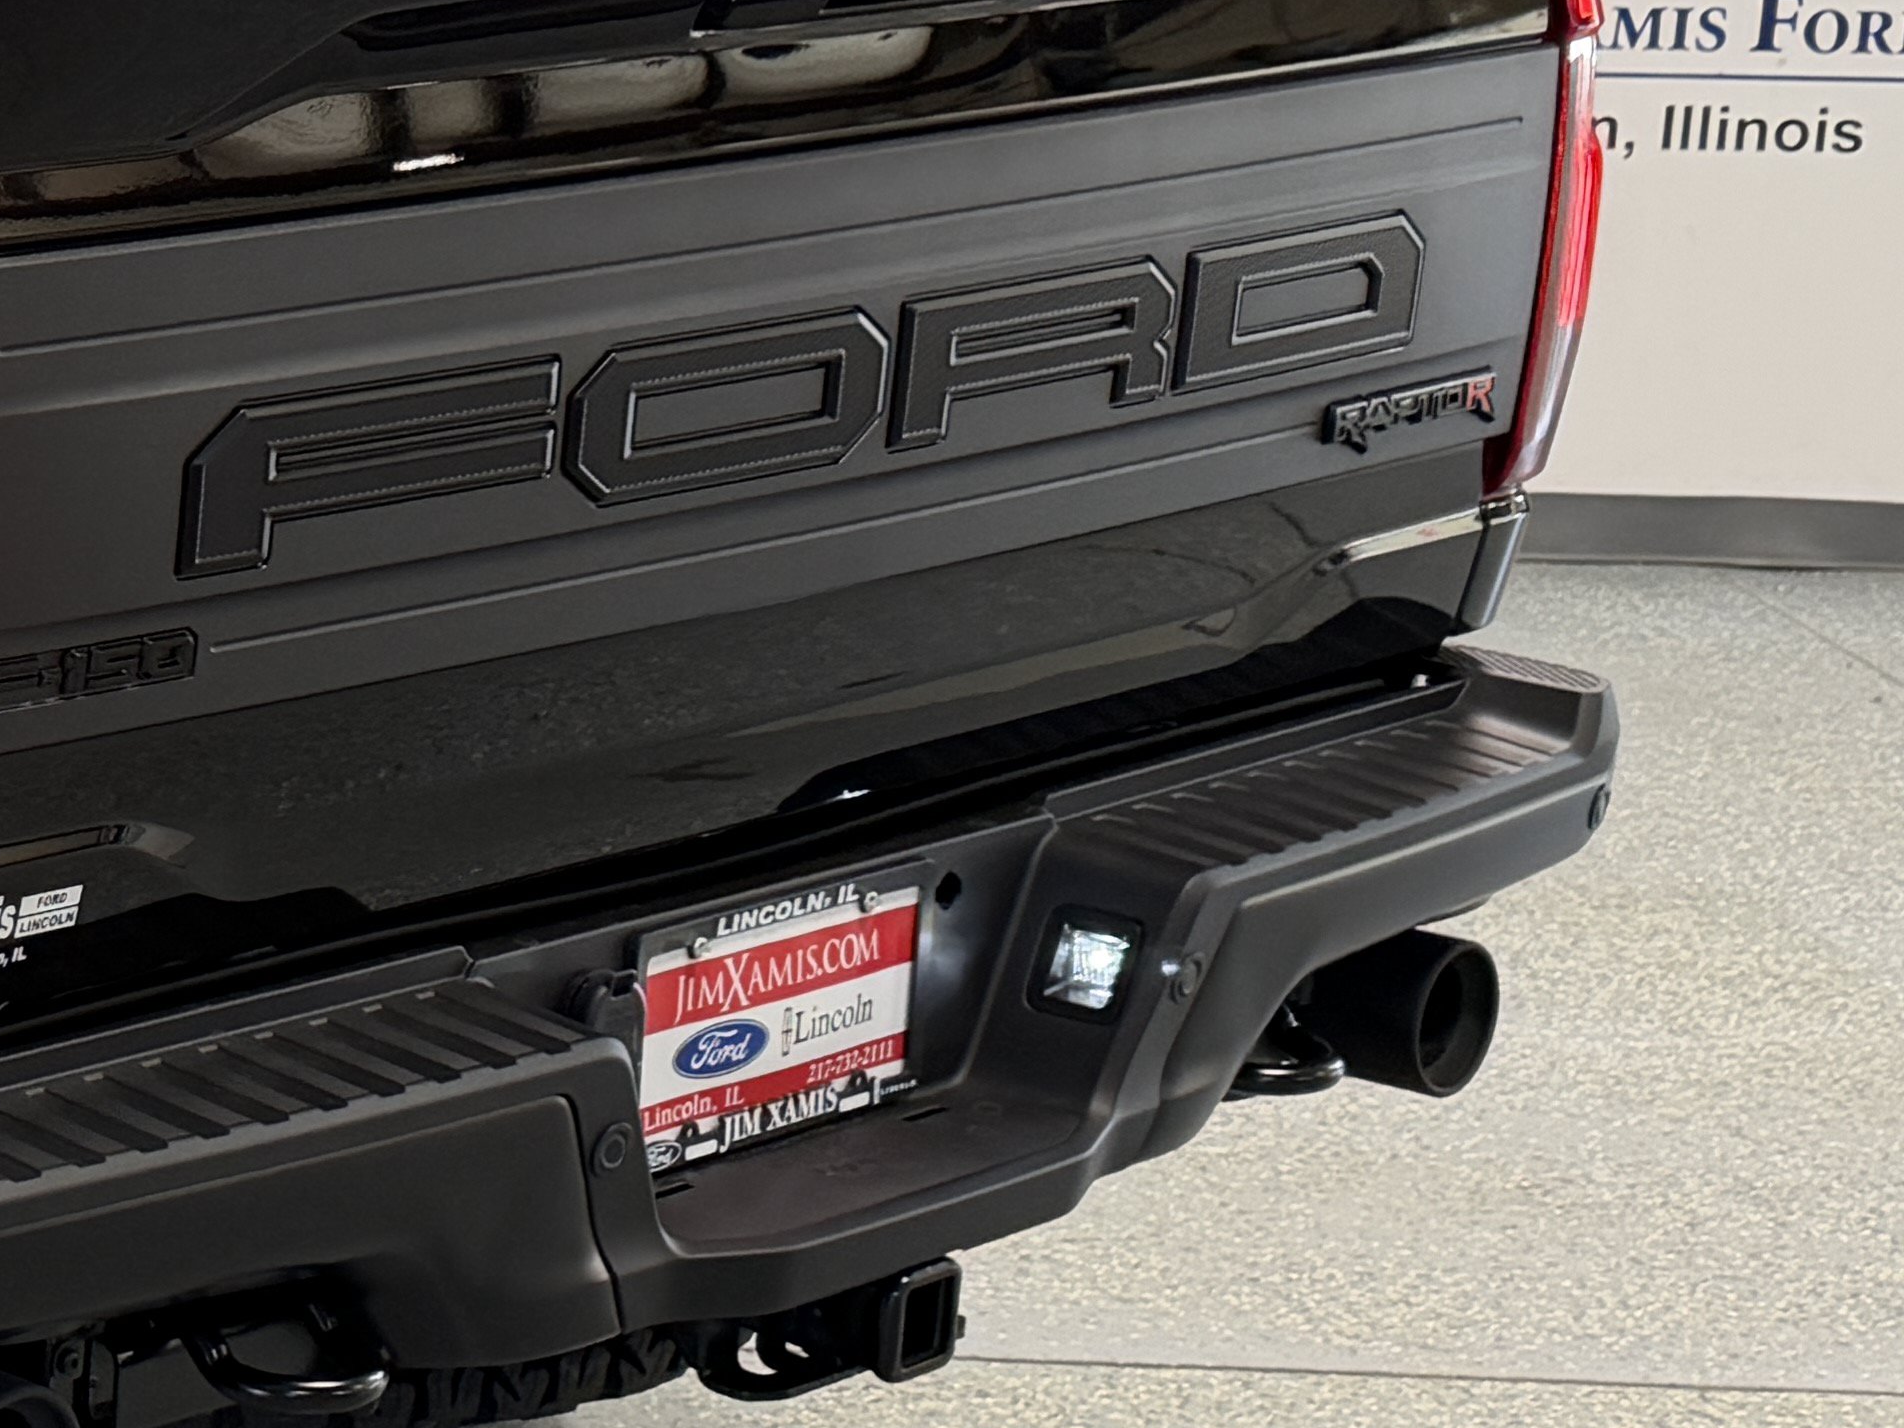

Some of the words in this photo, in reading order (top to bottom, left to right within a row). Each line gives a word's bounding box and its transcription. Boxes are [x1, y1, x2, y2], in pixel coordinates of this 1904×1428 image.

[1596, 6, 1728, 52] MIS
[1661, 105, 1864, 153] Illinois
[176, 211, 1426, 579] FORD
[1321, 366, 1497, 454] RAPTOR
[717, 891, 832, 937] LINCOLN,
[838, 883, 860, 904] IL
[674, 929, 881, 1024] JIMXAMIS.COM
[793, 993, 874, 1045] Lincoln
[691, 1030, 751, 1070] Ford
[807, 1039, 894, 1084] 217-732-2111
[644, 1091, 718, 1131] Lincoln,
[725, 1087, 745, 1106] IL
[719, 1113, 763, 1153] JIM
[766, 1086, 839, 1132] XAMIS
